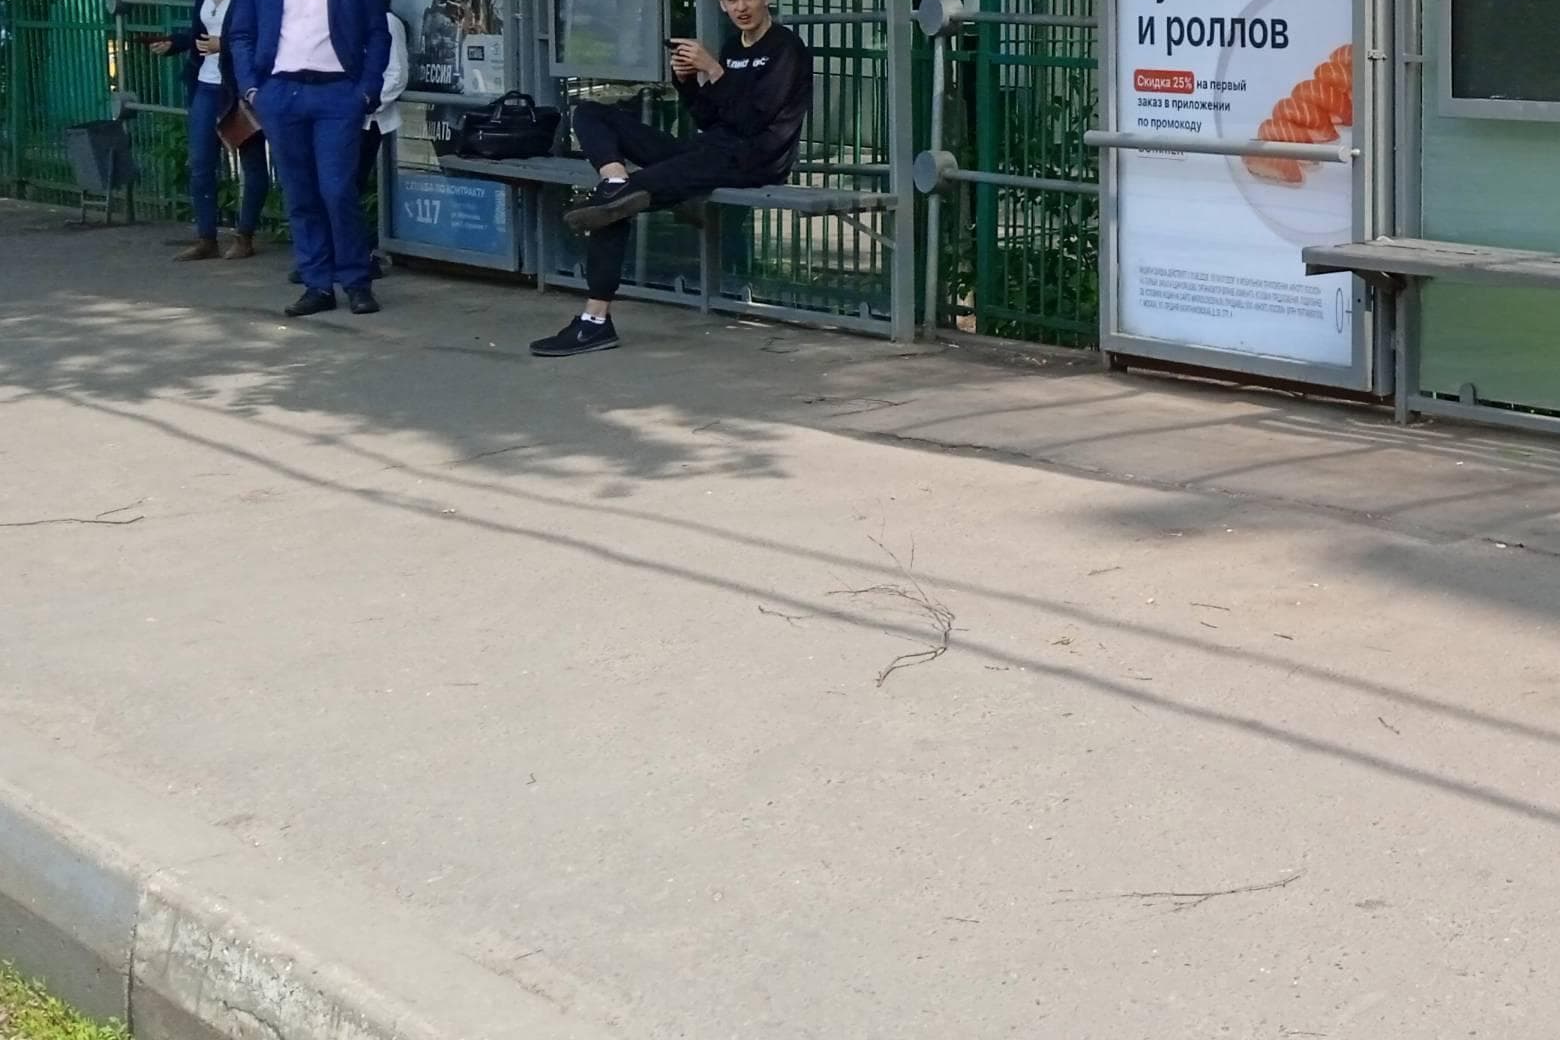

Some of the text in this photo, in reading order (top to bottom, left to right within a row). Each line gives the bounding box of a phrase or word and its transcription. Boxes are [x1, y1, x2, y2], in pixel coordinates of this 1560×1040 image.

[1138, 15, 1290, 56] и роллов
[1137, 75, 1247, 93] Скидка 25% на первый
[1137, 97, 1231, 112] заказ в приложении
[1137, 117, 1202, 133] по промокоду
[416, 198, 440, 225] 117
